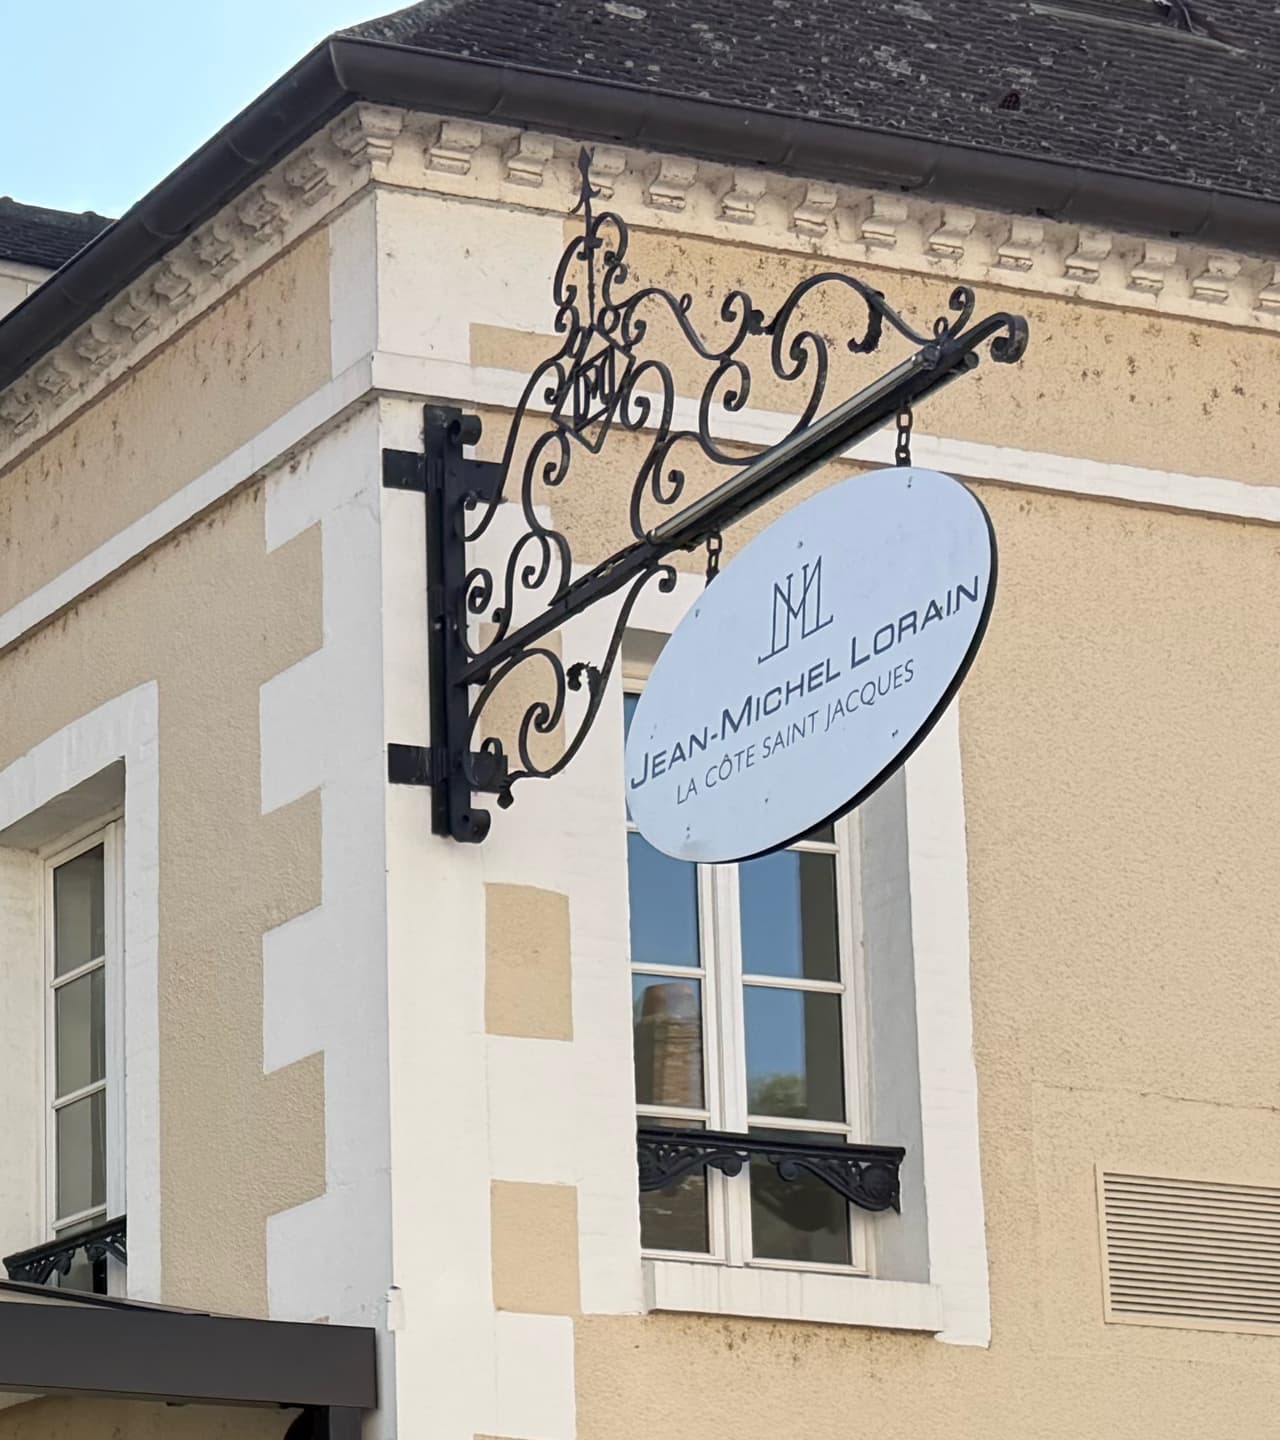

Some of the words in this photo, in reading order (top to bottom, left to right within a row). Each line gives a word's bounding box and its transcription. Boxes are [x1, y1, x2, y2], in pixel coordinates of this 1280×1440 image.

[630, 657, 842, 791] JEAN-MICHEL
[850, 575, 980, 670] LORAIN
[676, 777, 699, 806] LA
[704, 744, 756, 790] CÔTE
[762, 709, 820, 761] SAINT
[824, 658, 915, 733] JACQUES
